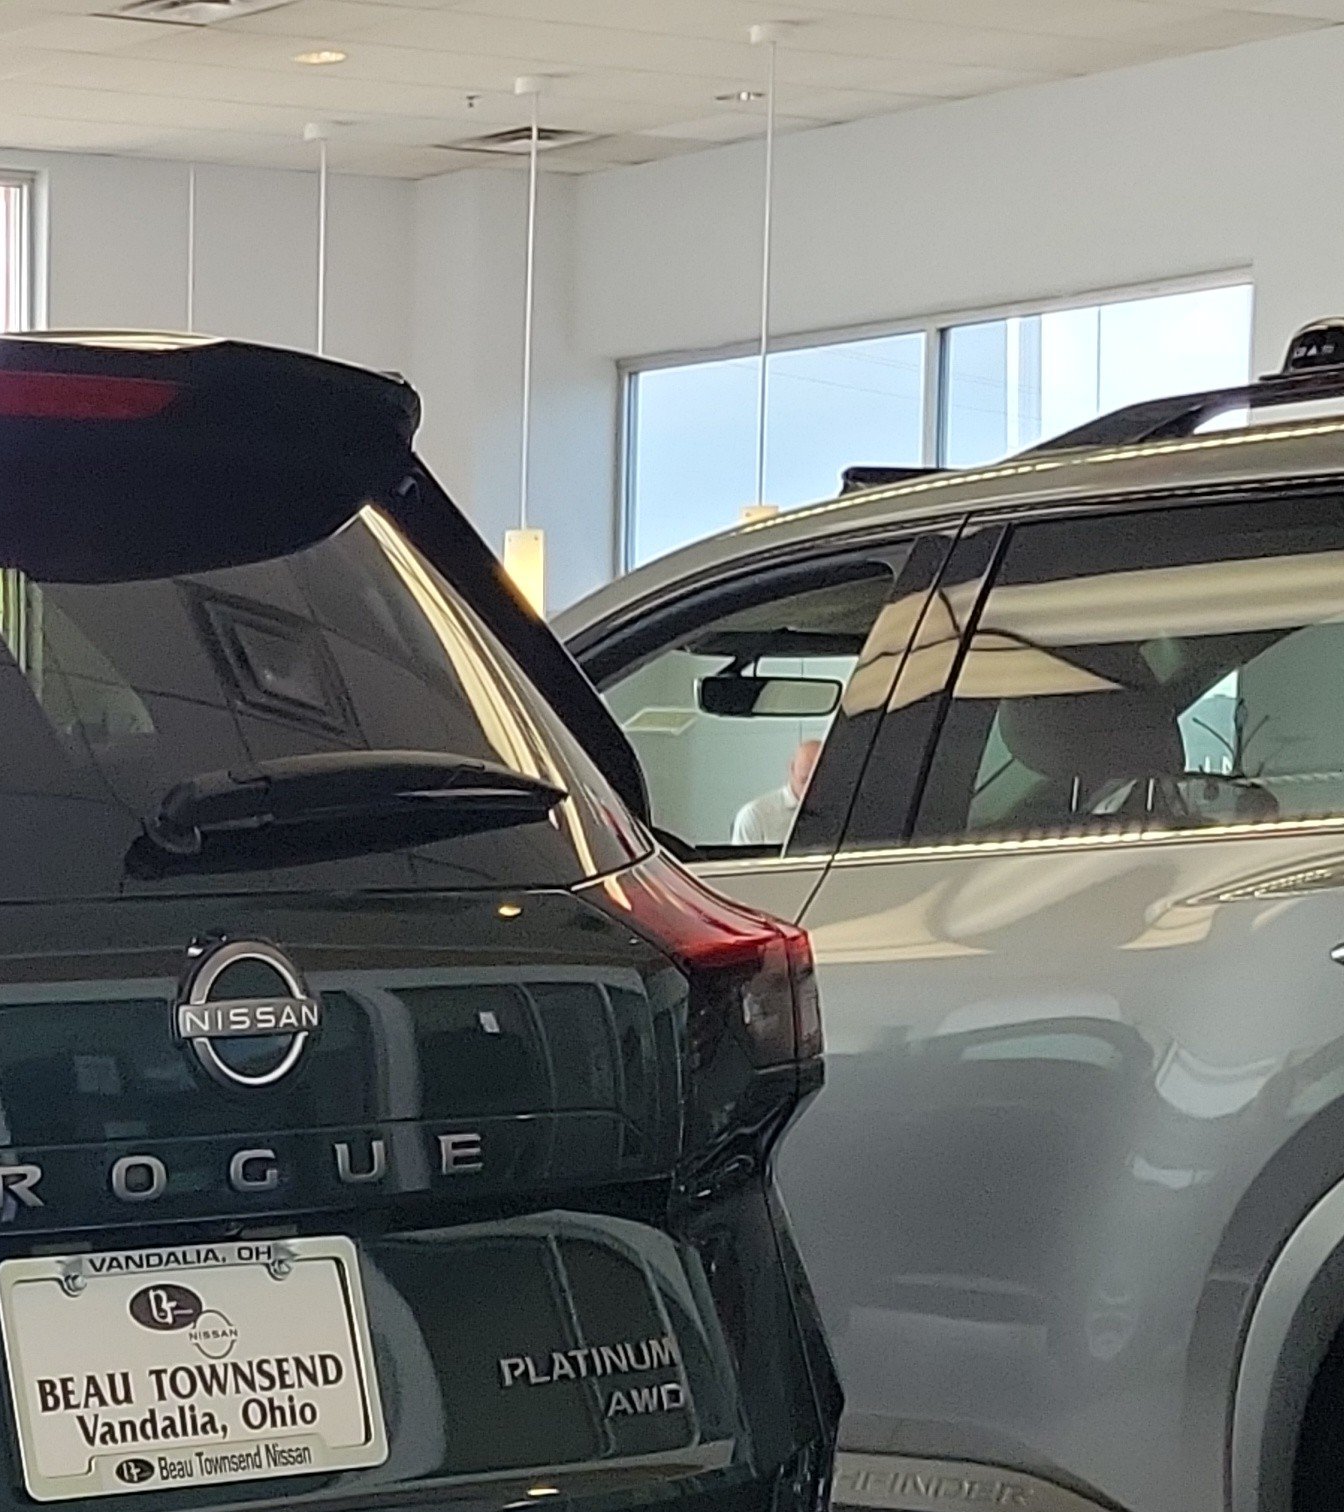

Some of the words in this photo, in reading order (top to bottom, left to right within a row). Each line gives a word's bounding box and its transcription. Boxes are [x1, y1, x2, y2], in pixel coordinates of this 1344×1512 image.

[185, 1003, 318, 1032] NISSAN
[88, 1249, 227, 1274] VANDALIA,
[237, 1246, 272, 1262] OH
[189, 1328, 238, 1341] NISSAN
[500, 1337, 678, 1387] PLATINUM
[37, 1370, 133, 1414] BEAU
[149, 1353, 343, 1401] TOWNSEND
[607, 1382, 684, 1417] AWD
[76, 1404, 229, 1447] Vandalia,
[241, 1394, 318, 1431] Ohio
[158, 1456, 194, 1481] Beau
[195, 1444, 263, 1477] Townsend
[265, 1443, 312, 1469] Nissan
